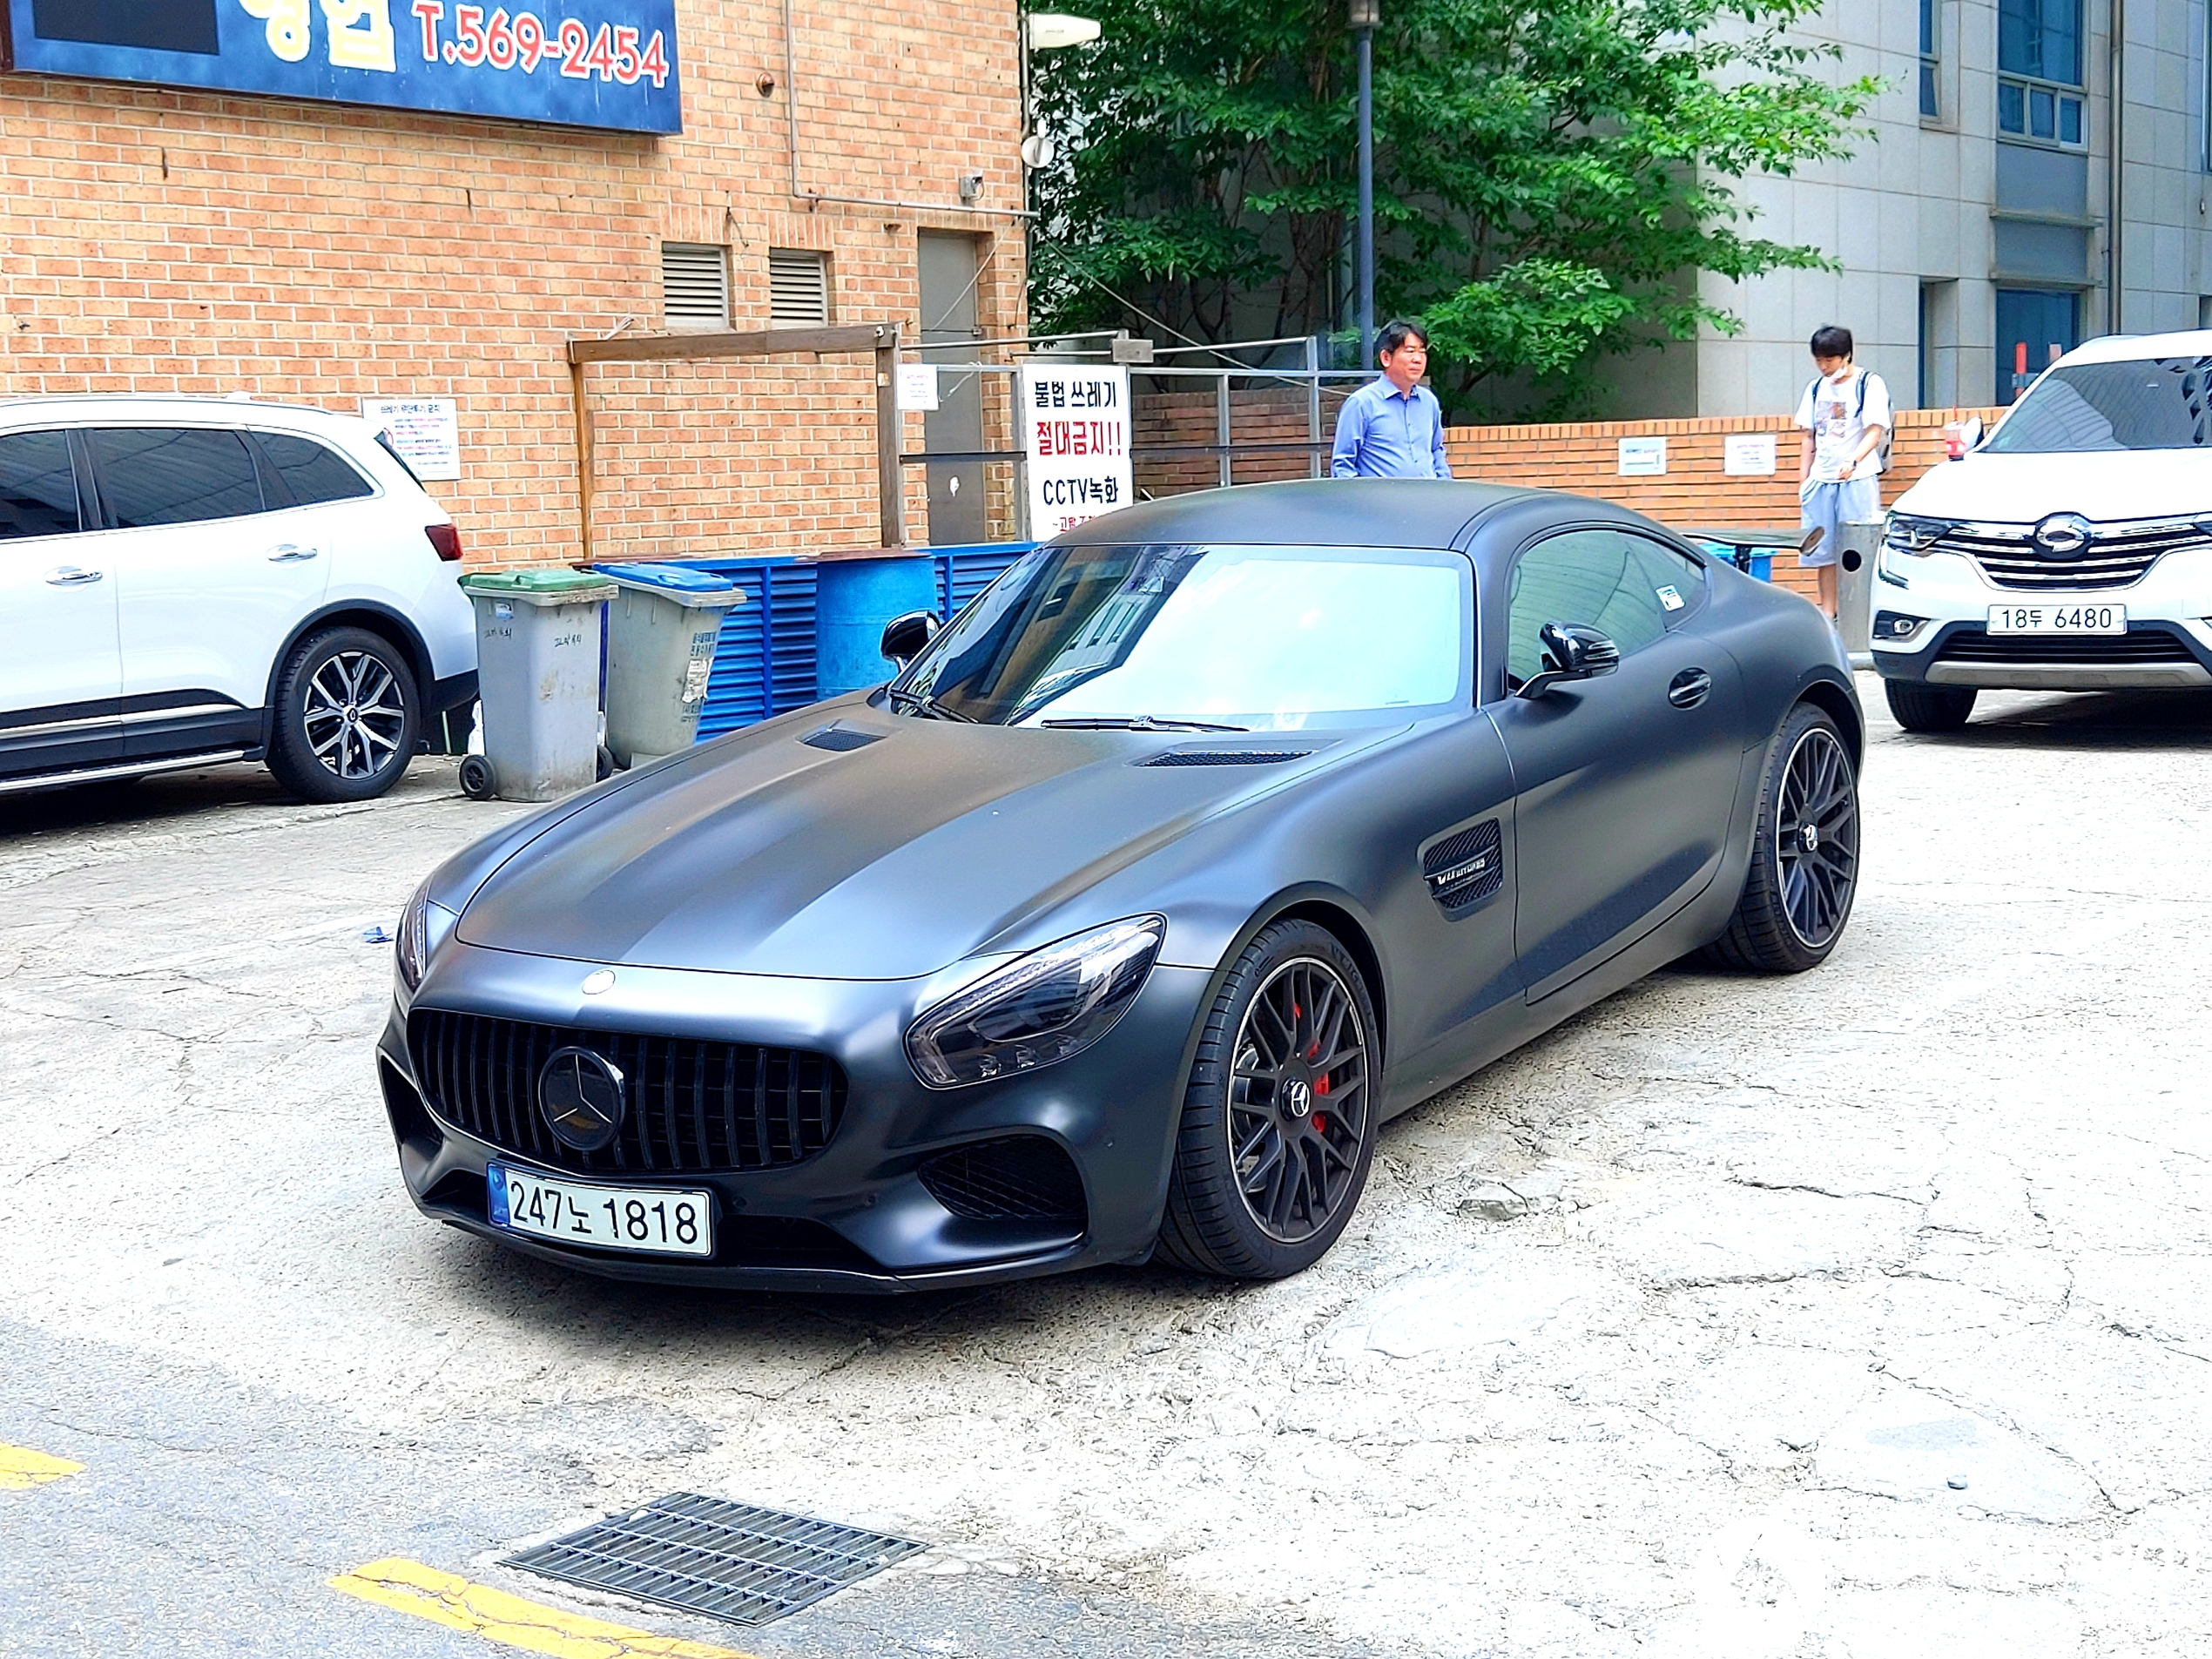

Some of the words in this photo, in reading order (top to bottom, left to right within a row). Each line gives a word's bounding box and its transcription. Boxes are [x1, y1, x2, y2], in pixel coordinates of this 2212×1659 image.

[411, 0, 671, 88] T.569-2454
[1071, 381, 1116, 408] 쓰레기
[1036, 421, 1121, 456] 절대금지!!
[2001, 610, 2042, 629] 18두
[2054, 608, 2112, 629] 6480
[510, 1180, 592, 1235] 247노
[603, 1197, 698, 1244] 1818
